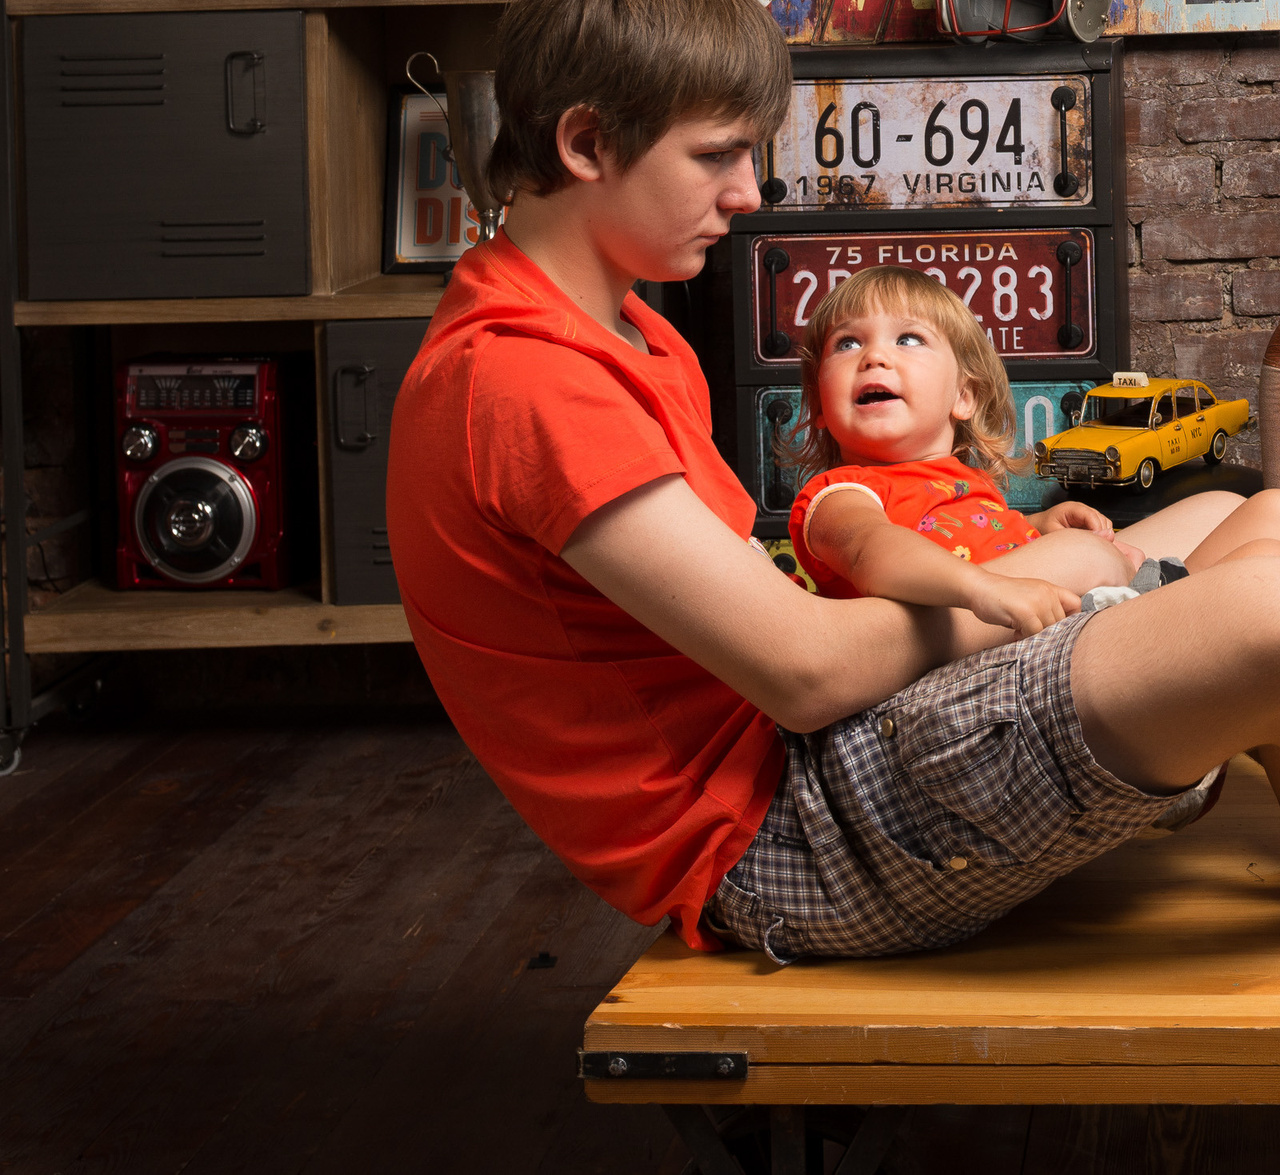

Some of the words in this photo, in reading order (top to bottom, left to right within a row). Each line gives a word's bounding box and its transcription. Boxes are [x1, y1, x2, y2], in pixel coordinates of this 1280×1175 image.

[795, 173, 877, 197] 1967
[902, 171, 1046, 195] VIRGINIA
[825, 245, 864, 266] 75
[878, 242, 1019, 265] FLORIDA
[1117, 378, 1137, 386] TAXI
[1191, 427, 1202, 439] NYC
[1168, 437, 1181, 447] TAXI
